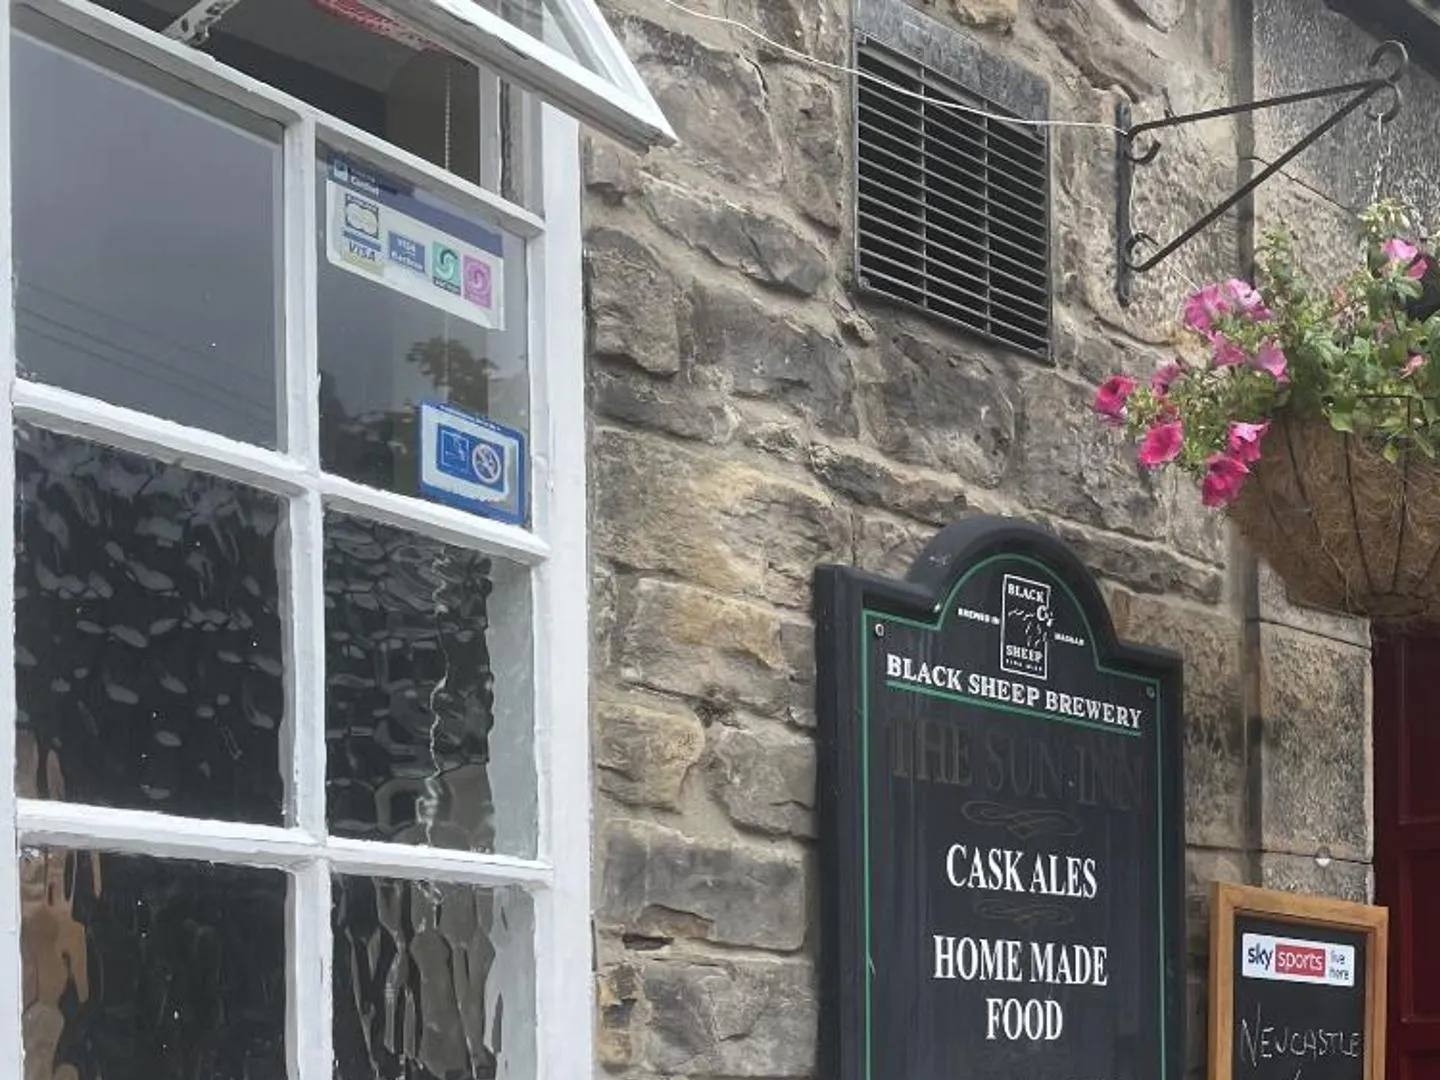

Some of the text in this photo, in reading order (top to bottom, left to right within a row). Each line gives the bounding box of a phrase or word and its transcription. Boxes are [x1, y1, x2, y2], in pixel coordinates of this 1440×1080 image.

[349, 240, 376, 262] VISA
[1007, 583, 1044, 603] BLACK
[1006, 645, 1043, 662] SHEEP
[886, 653, 961, 692] BLACK
[968, 674, 1039, 708] SHEEP
[1045, 692, 1143, 730] BREWERY
[946, 843, 1098, 899] CASK ALES
[933, 935, 1108, 986] HOME MADE
[1248, 943, 1323, 973] sky sports
[986, 998, 1063, 1040] FOOD
